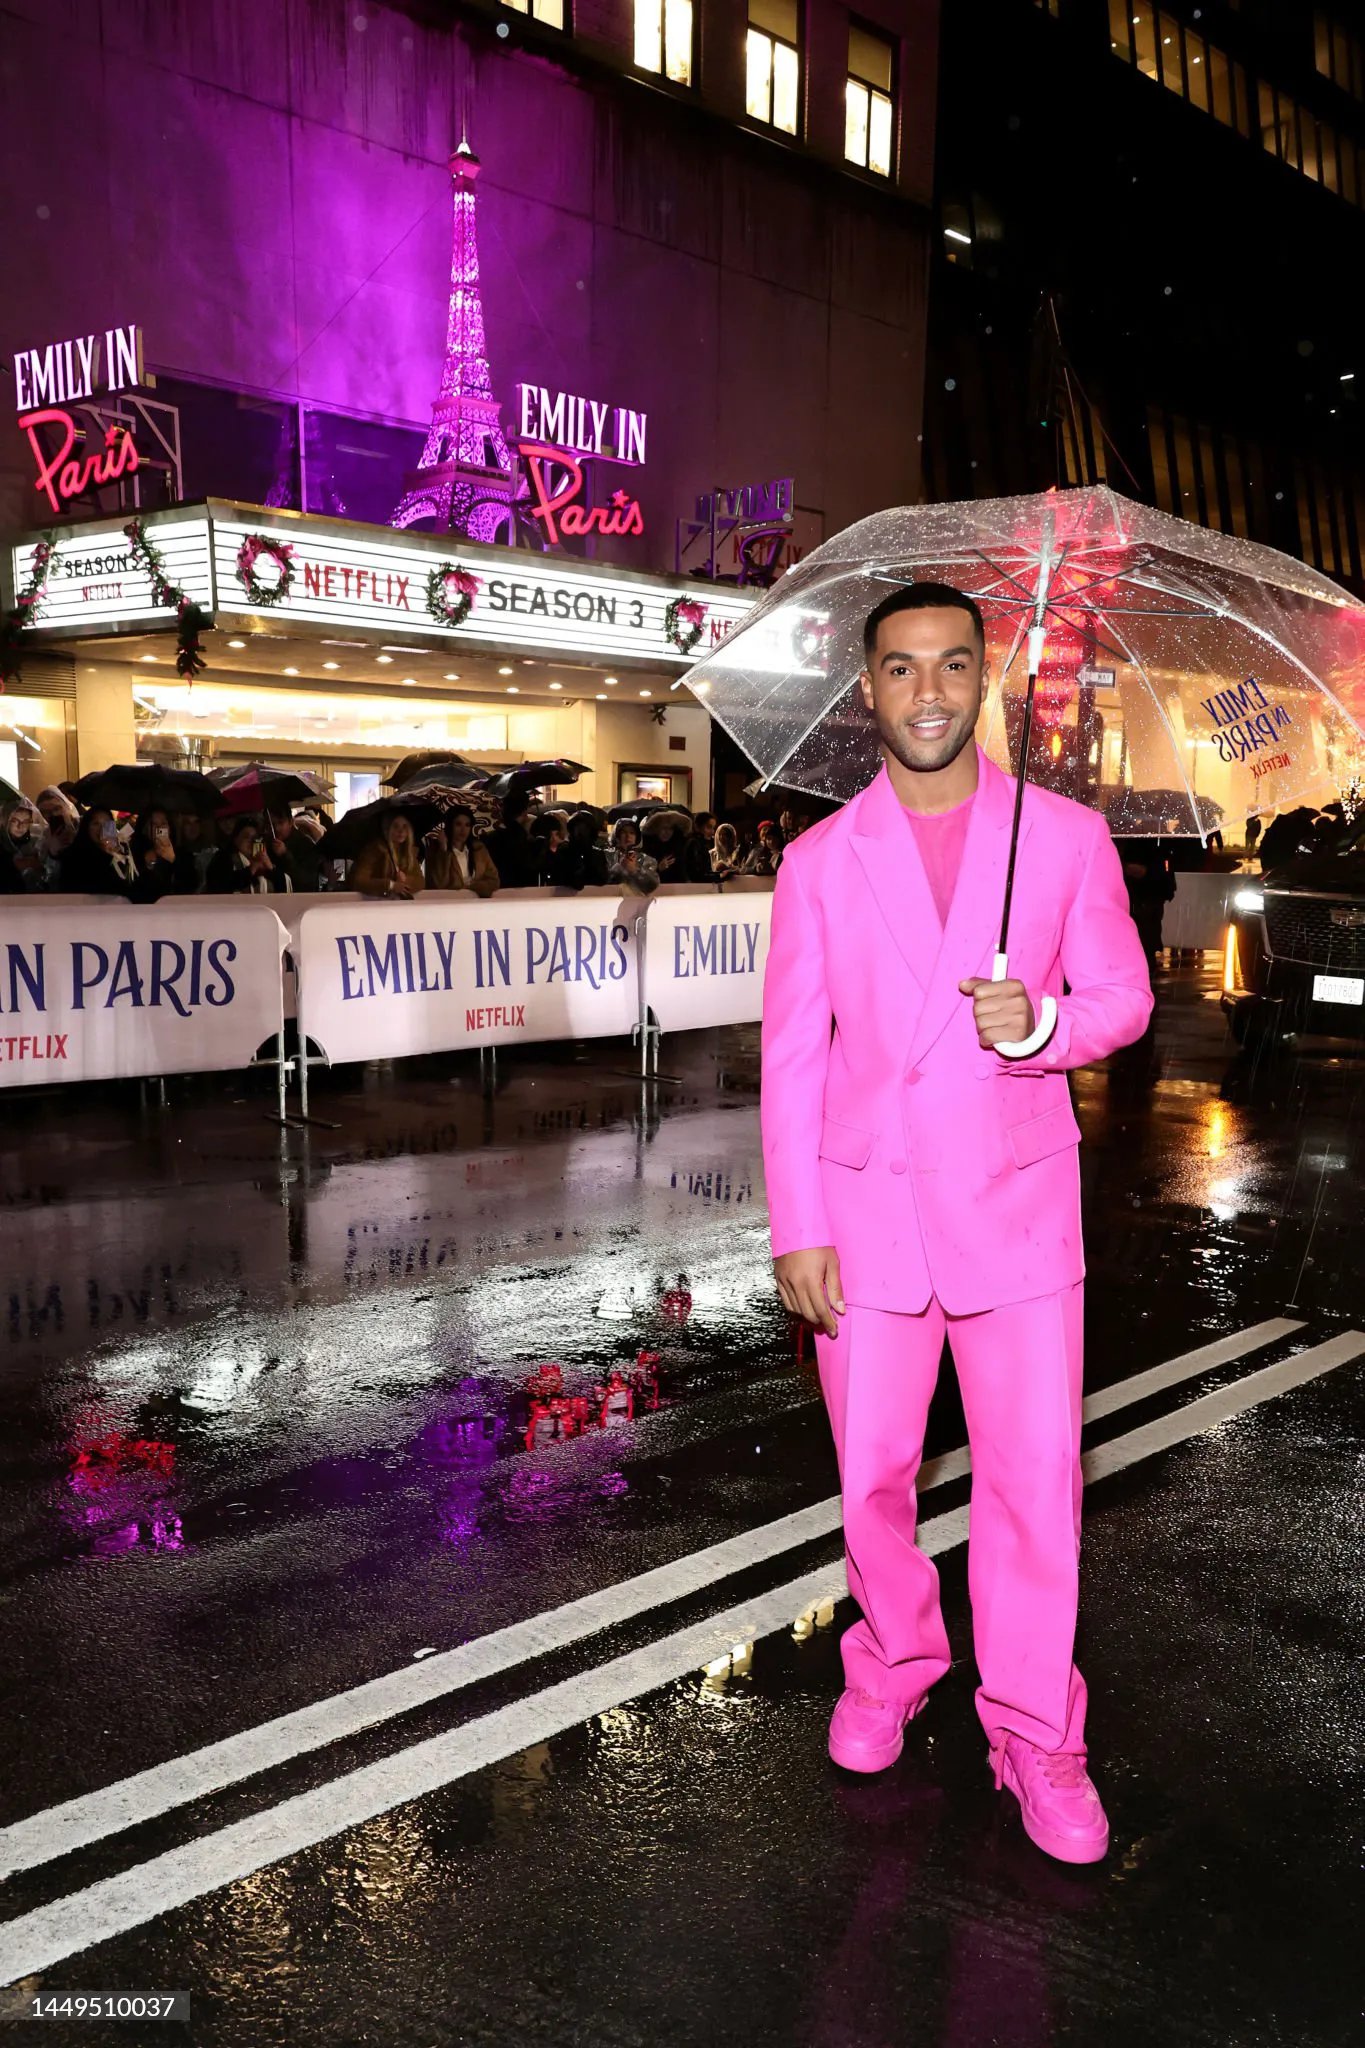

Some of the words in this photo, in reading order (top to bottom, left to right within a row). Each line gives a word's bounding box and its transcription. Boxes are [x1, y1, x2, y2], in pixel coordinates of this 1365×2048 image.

[13, 335, 95, 411] EMILY
[105, 325, 139, 391] IN
[520, 383, 609, 454] EMILY
[616, 407, 647, 464] IN
[18, 409, 139, 513] Paris
[518, 444, 644, 544] Paris
[64, 553, 128, 577] SEASON
[82, 582, 123, 602] NETFLIX
[304, 563, 410, 611] NETFLIX
[488, 580, 616, 625] SEASON
[629, 600, 644, 628] 3
[0, 944, 48, 1013] N
[70, 939, 237, 1017] PARIS
[335, 931, 456, 1000] EMILY
[473, 928, 511, 988] IN
[525, 924, 629, 990] PARIS
[673, 923, 760, 978] EMILY
[465, 1005, 526, 1032] NETFLIX
